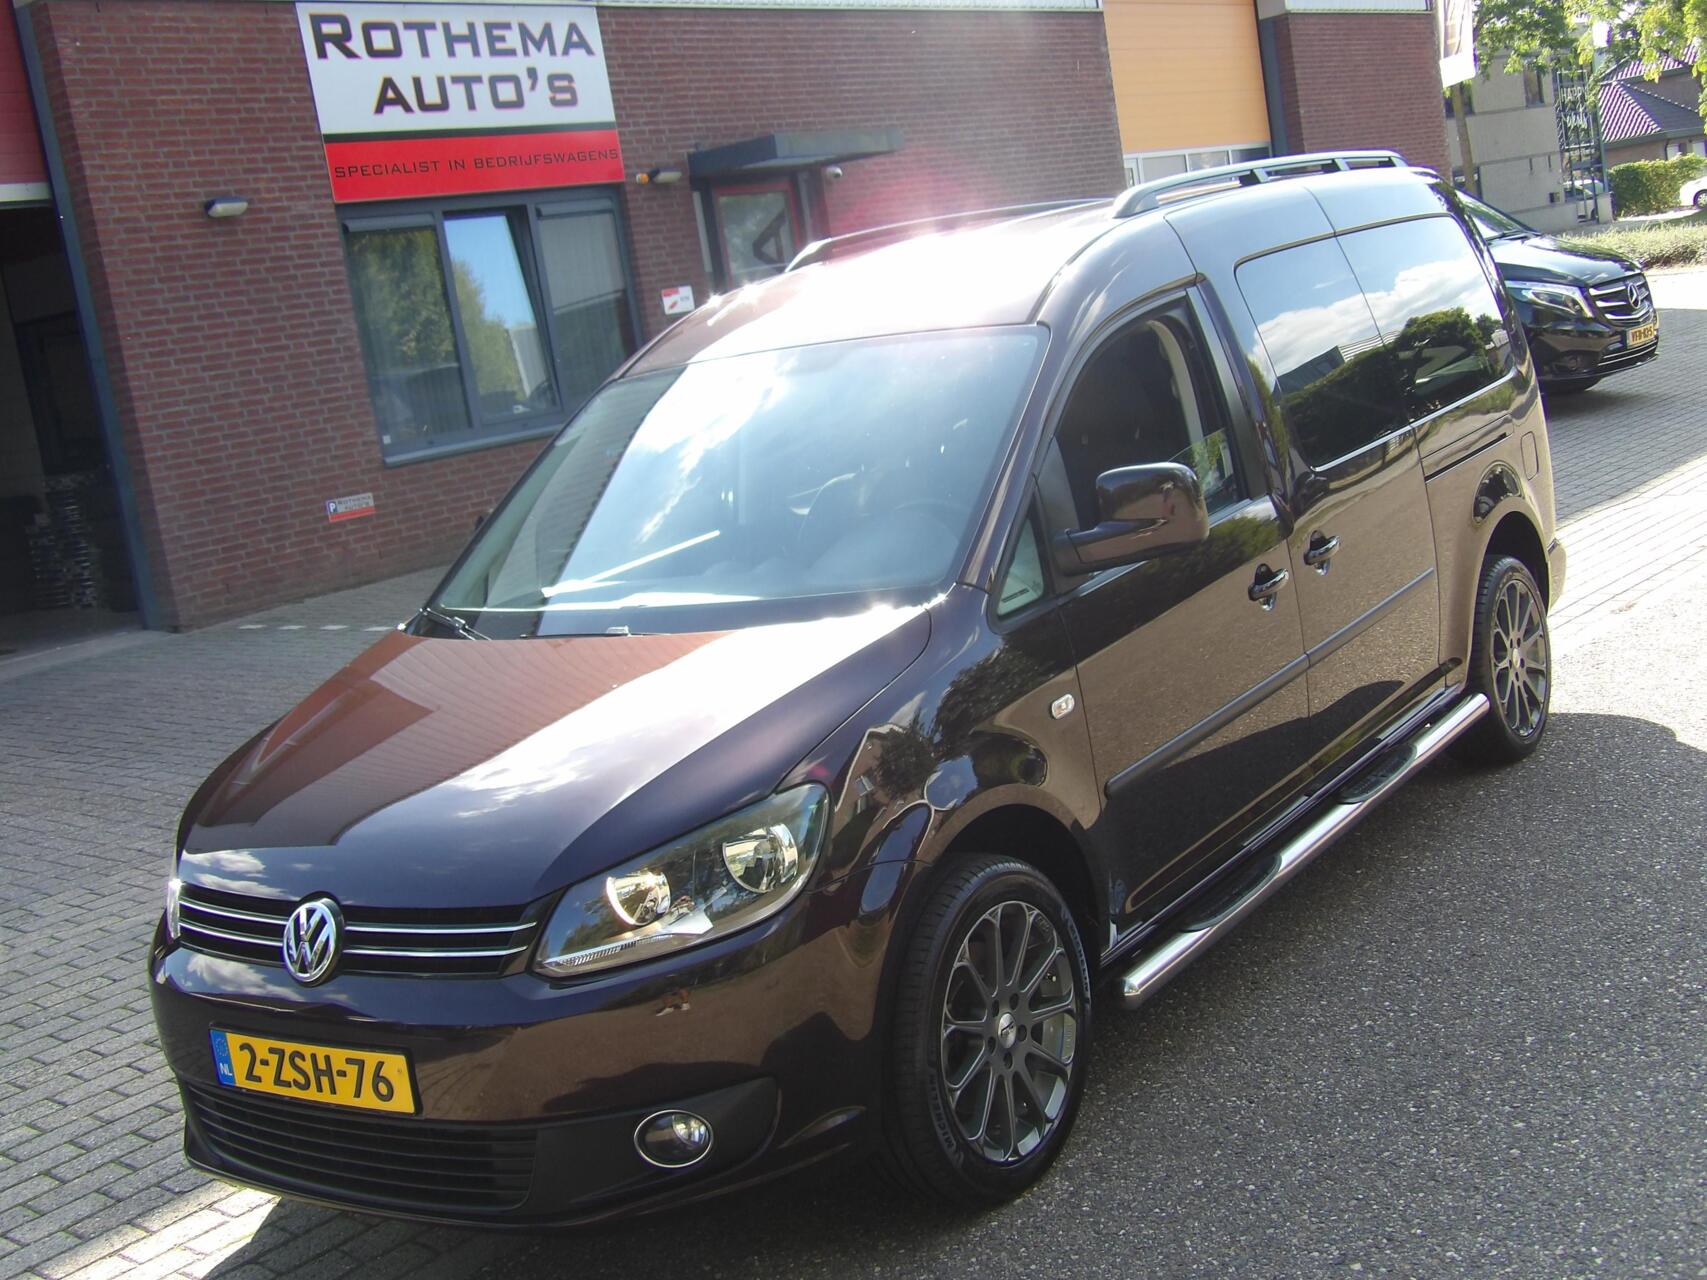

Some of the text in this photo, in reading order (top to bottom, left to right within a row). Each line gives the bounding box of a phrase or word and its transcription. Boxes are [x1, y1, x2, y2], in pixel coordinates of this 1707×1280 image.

[309, 13, 596, 60] ROTHEMA
[373, 67, 579, 115] AUTO'S
[334, 149, 619, 179] SPECIALIST IN BEDRIJFSWAGENS
[219, 1062, 233, 1077] NL
[239, 1042, 395, 1103] 2-ZSH-76
